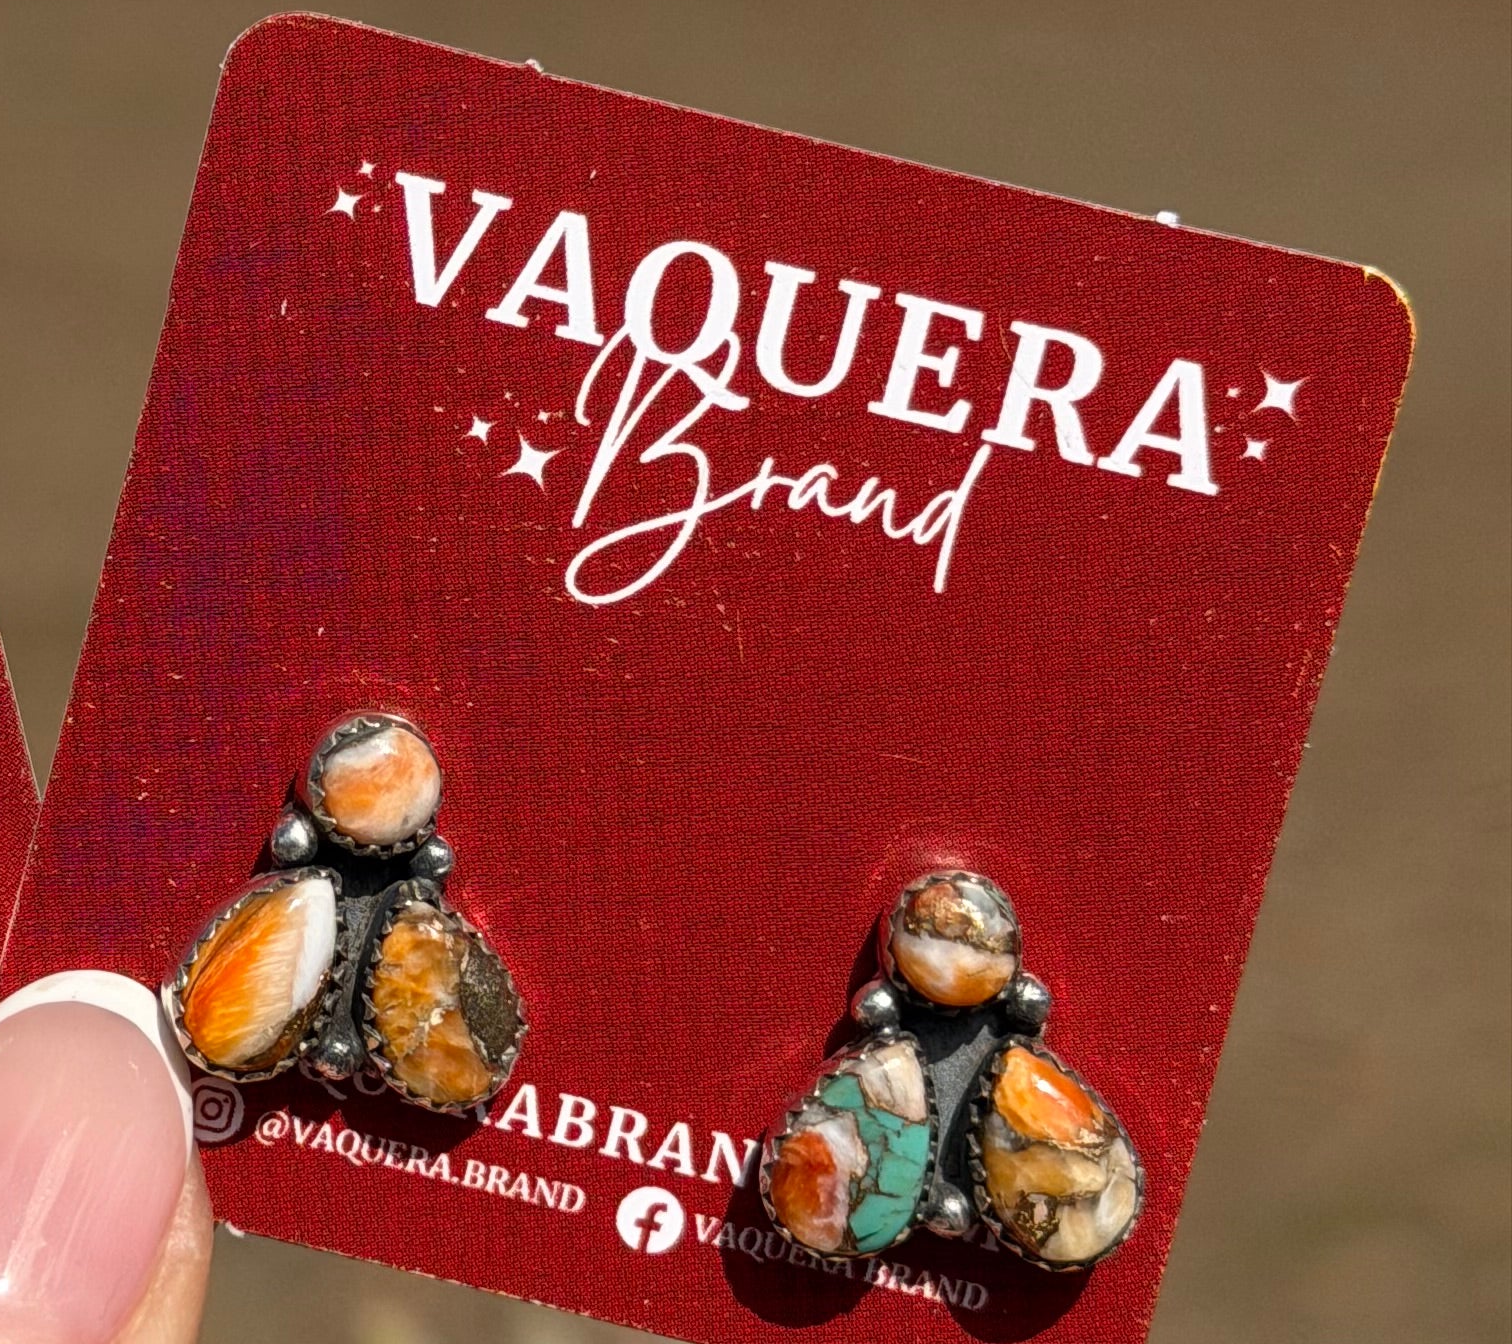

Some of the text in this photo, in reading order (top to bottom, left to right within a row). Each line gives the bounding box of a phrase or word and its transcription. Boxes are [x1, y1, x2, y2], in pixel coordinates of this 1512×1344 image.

[394, 170, 1221, 497] VAQUERA
[564, 324, 992, 605] Brand
[254, 1109, 587, 1215] @VAQUERA.BRAND
[863, 1256, 990, 1312] BRAND
